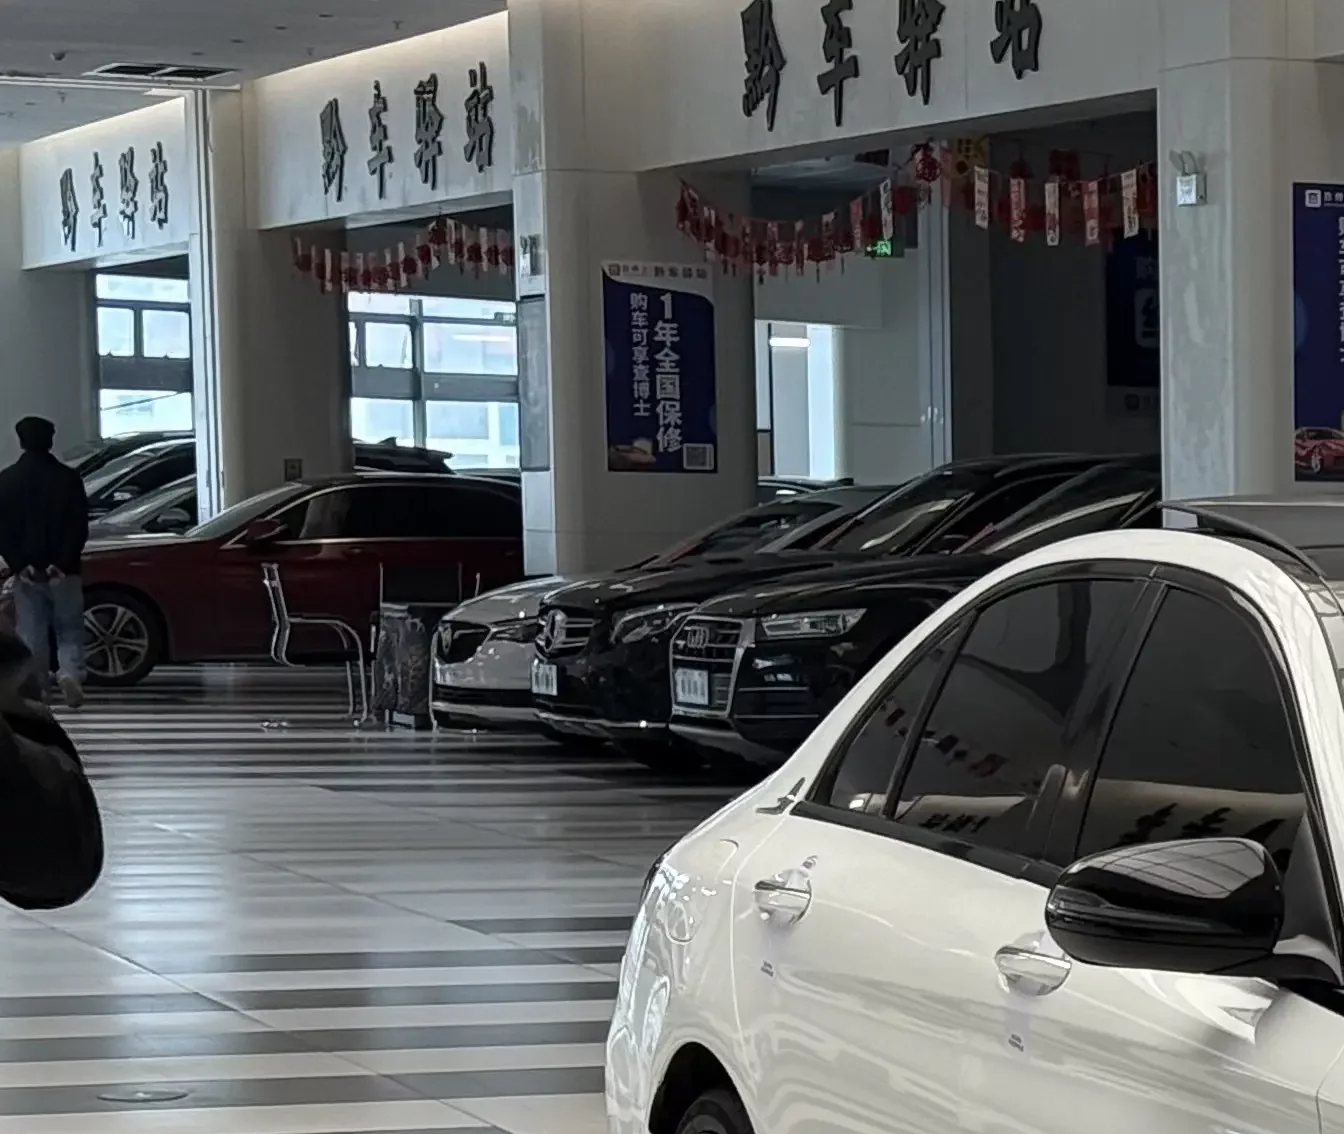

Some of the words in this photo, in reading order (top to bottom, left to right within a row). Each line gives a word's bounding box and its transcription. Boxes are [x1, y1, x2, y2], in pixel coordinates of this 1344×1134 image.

[654, 292, 683, 453] 1年全国保修
